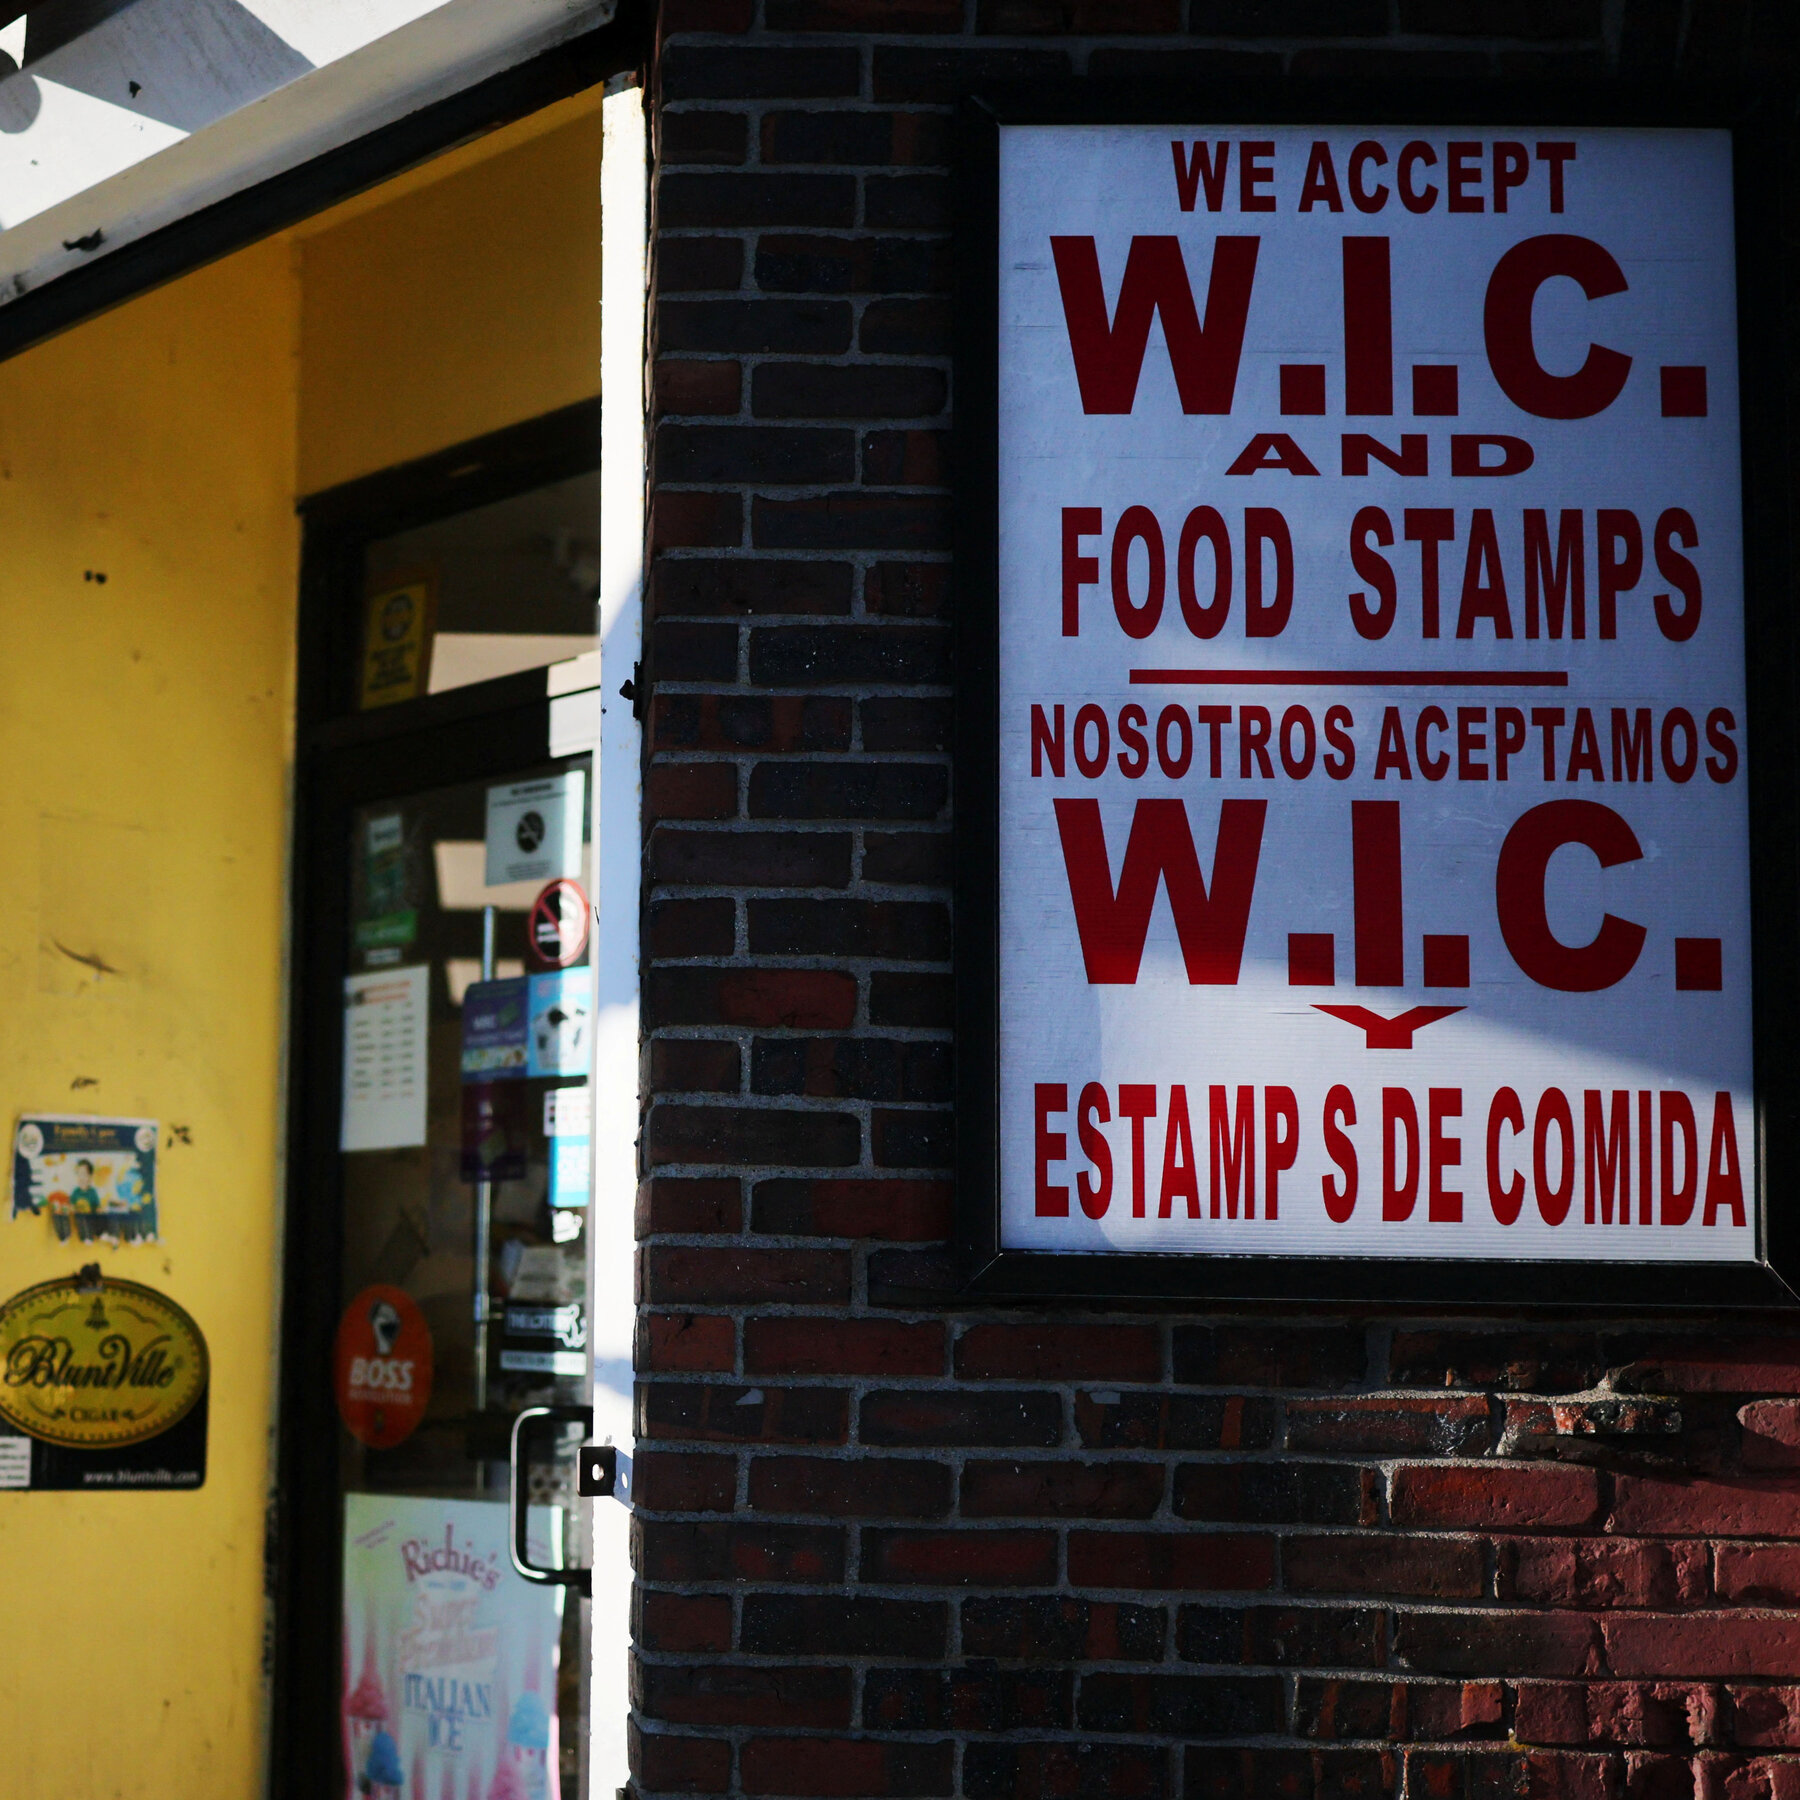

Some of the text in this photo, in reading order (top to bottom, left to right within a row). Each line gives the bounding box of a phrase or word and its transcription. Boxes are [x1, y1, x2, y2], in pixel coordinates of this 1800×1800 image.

[1171, 140, 1577, 214] WE ACCEPT
[1049, 234, 1708, 420] W.I.C.
[1224, 433, 1535, 477] AND
[1060, 505, 1703, 642] FOOD STAMPS
[1030, 703, 1740, 785] NOSOTROS ACEPTAMOS
[1052, 797, 1723, 993] W.I.C.
[1309, 1004, 1469, 1049] Y
[1382, 1086, 1463, 1223] DE
[1486, 1087, 1747, 1228] COMIDA
[349, 1356, 415, 1391] BOSS
[401, 1523, 500, 1591] Richie's
